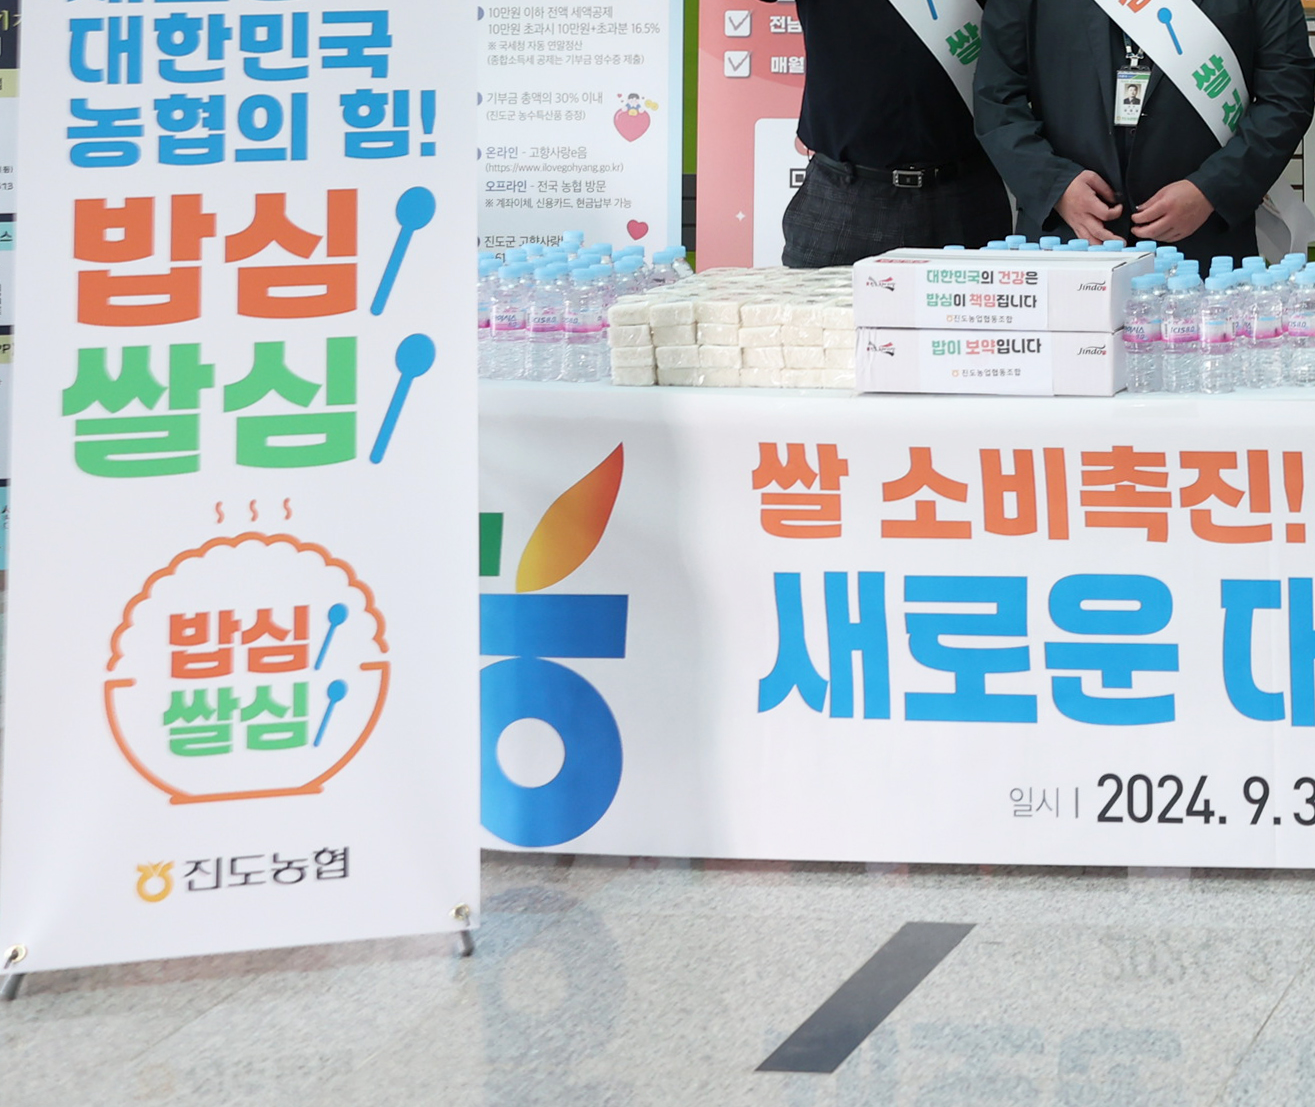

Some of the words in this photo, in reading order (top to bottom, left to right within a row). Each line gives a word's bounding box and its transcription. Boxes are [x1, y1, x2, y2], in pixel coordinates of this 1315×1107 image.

[68, 9, 393, 85] 대한민국
[66, 89, 309, 169] 농협의
[339, 88, 437, 159] 힘!
[485, 146, 518, 159] 온라인
[485, 180, 527, 192] 오프라인
[537, 180, 558, 192] 전국
[73, 187, 359, 328] 밥심
[926, 269, 996, 285] 대한민국의
[998, 268, 1039, 286] 건강은
[926, 293, 967, 308] 밥심이
[969, 293, 1037, 309] 책임집니다
[931, 339, 962, 357] 밥이
[965, 337, 1042, 357] 보약입니다
[60, 335, 358, 479] 쌀심
[751, 440, 850, 540] 쌀
[880, 444, 1306, 545] 소비촉진!
[168, 604, 311, 681] 밥심
[756, 569, 1179, 726] 새로운
[162, 680, 310, 758] 쌀심
[1009, 785, 1061, 819] 일시
[1096, 773, 1228, 825] 2024.
[182, 845, 350, 893] 진도농협
